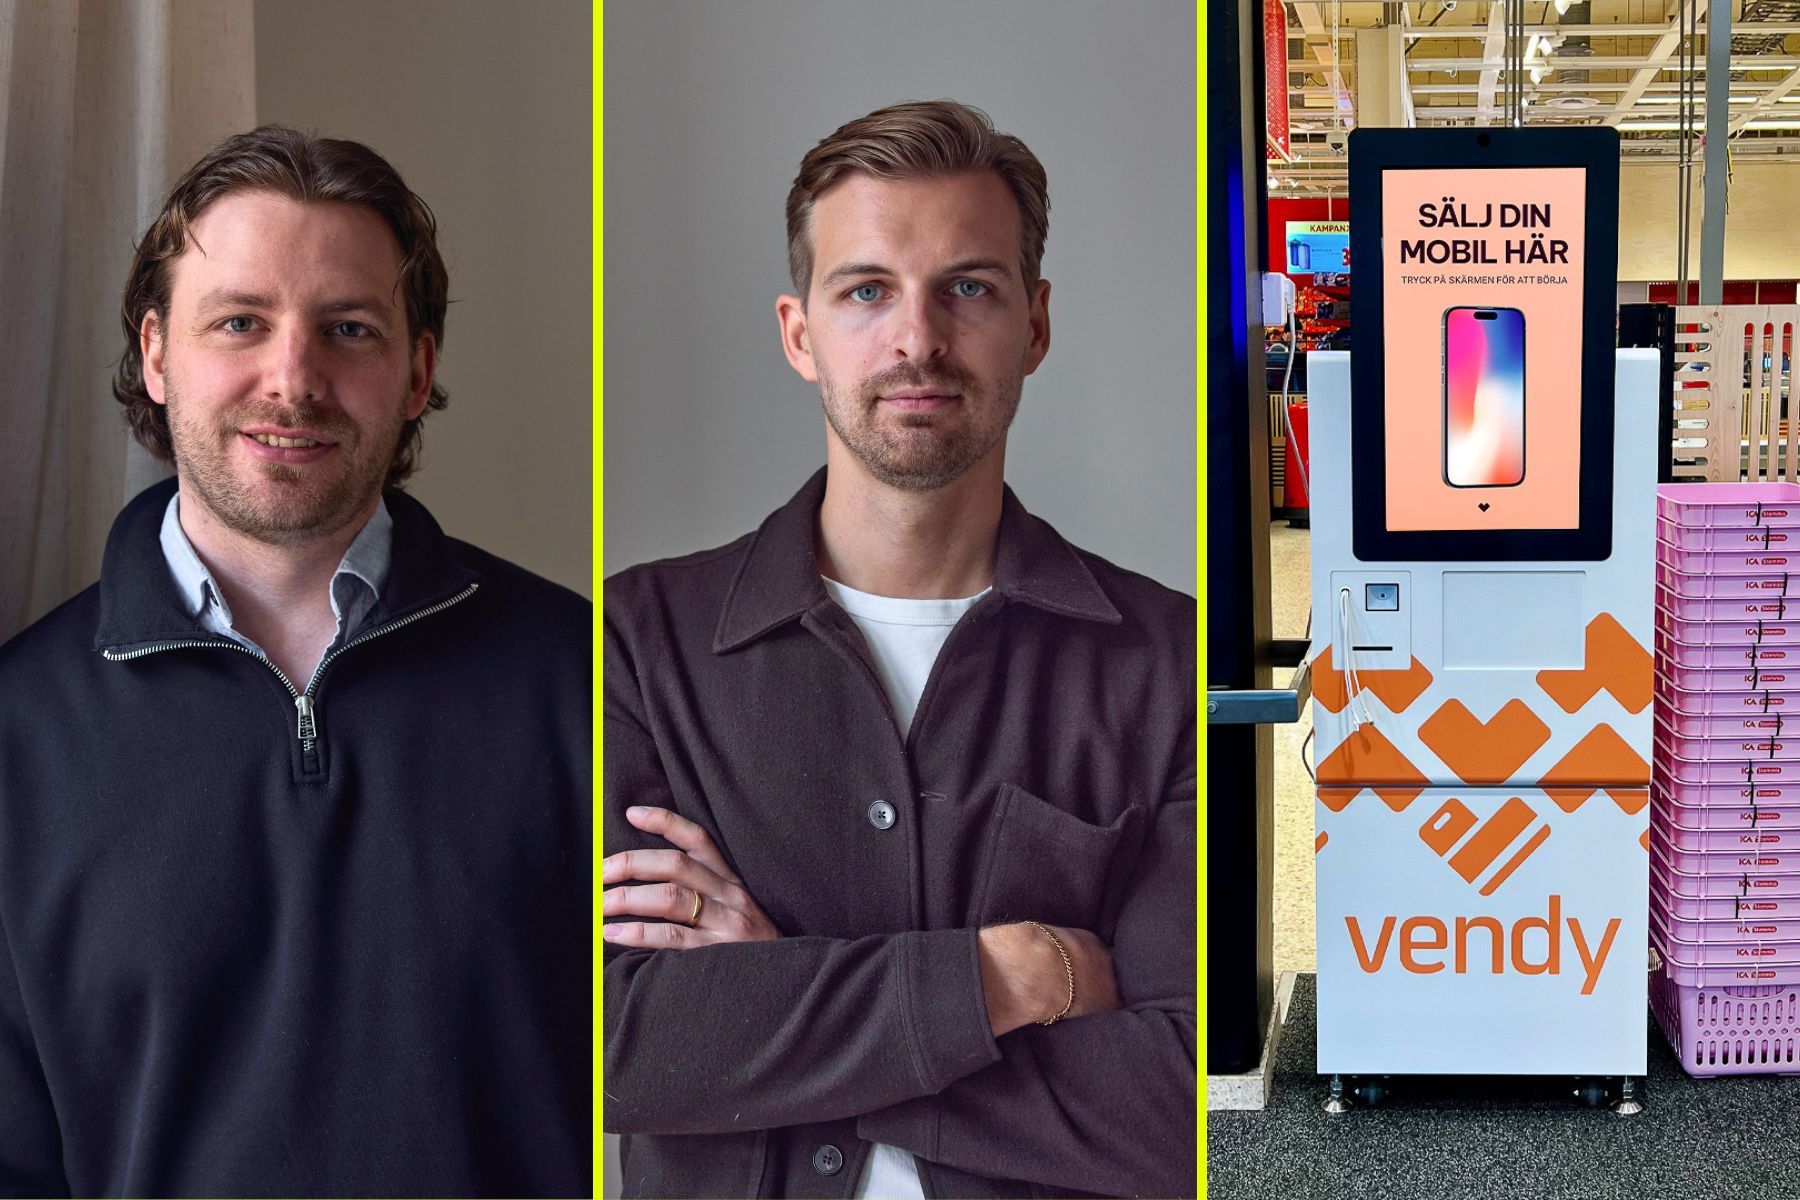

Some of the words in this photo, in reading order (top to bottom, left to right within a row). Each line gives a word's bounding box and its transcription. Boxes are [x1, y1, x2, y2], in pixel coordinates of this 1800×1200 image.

[1419, 196, 1492, 228] SÄLJ
[1500, 203, 1551, 228] DIN
[1400, 239, 1498, 264] MOBIL
[1505, 232, 1568, 264] HÄR
[1401, 275, 1431, 284] TRYCK
[1434, 274, 1446, 284] PÅ
[1449, 274, 1494, 284] SKÄRMEN
[1497, 274, 1515, 284] FÖR
[1518, 275, 1535, 284] ATT
[1537, 274, 1568, 284] BÖRJA
[1344, 895, 1622, 995] vendy
